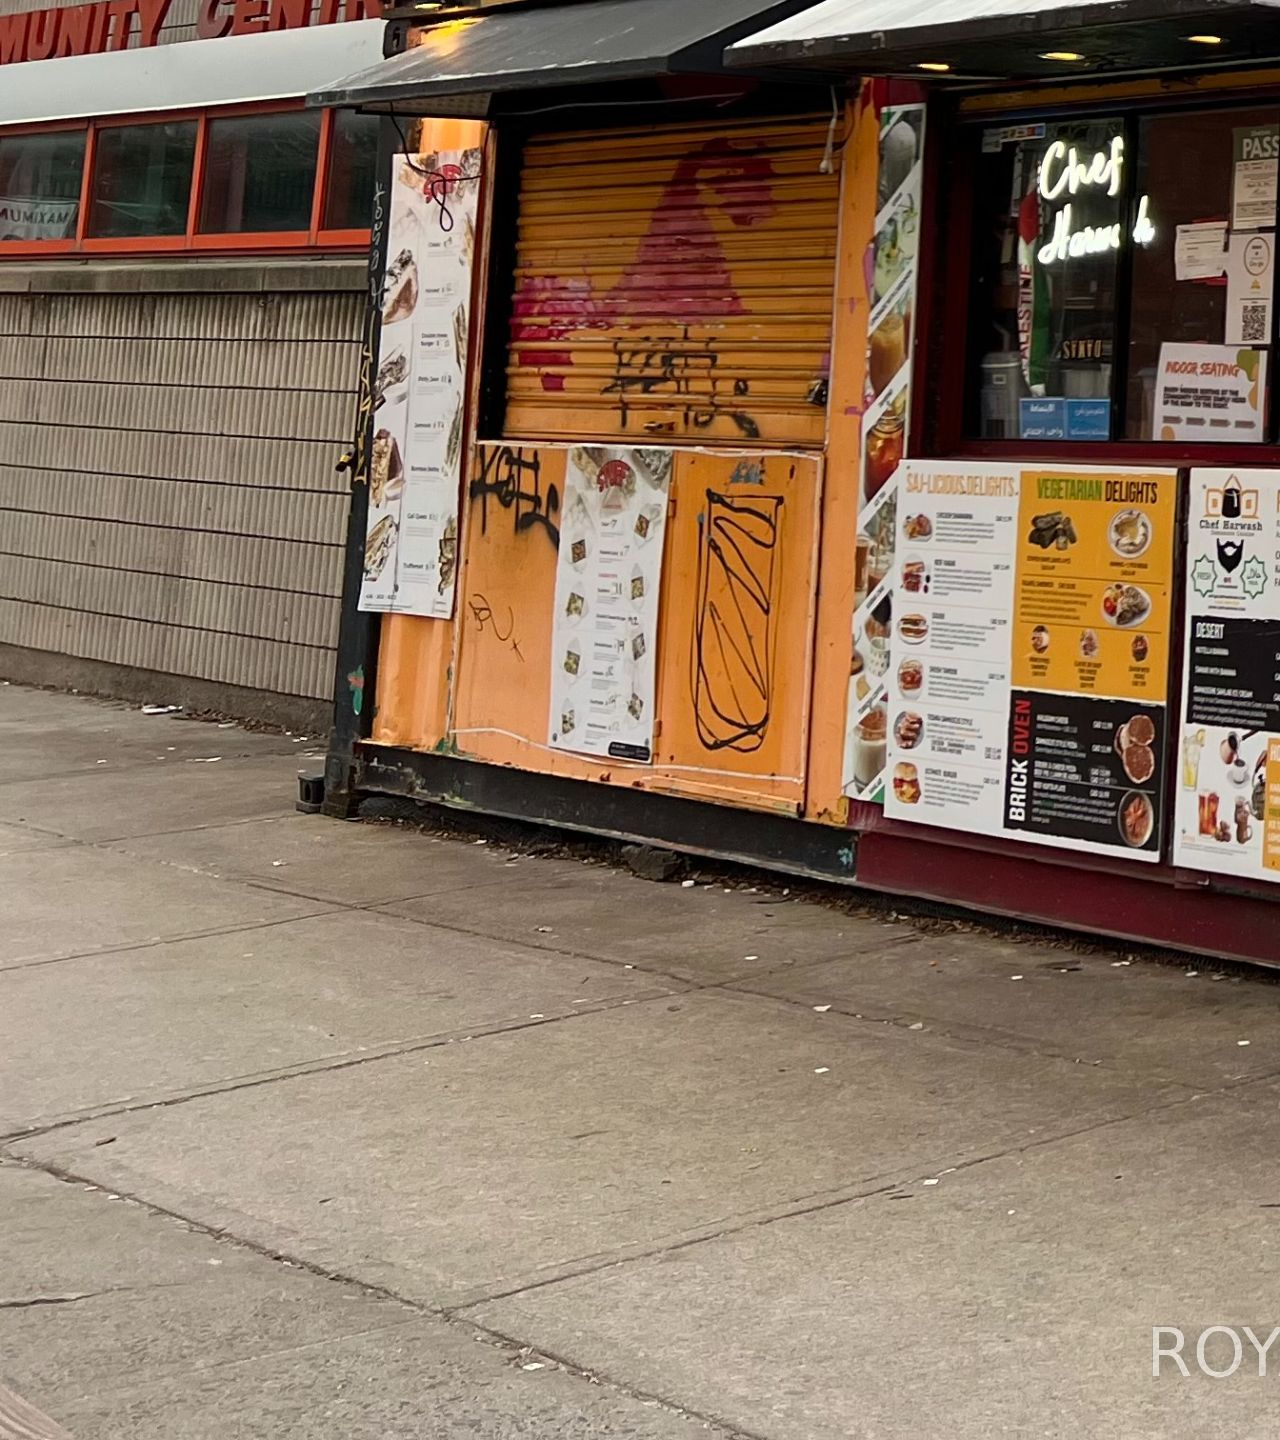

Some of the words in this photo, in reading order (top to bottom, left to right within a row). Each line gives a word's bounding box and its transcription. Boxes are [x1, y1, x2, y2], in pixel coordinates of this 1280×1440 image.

[1242, 136, 1279, 159] PASS
[1040, 136, 1124, 201] Chef
[1165, 361, 1197, 375] INDOOR
[1201, 362, 1240, 377] SEATING
[1037, 478, 1102, 501] VEGETARIAN
[1105, 481, 1158, 504] DELIGHTS
[1200, 520, 1219, 529] Chef
[1223, 520, 1262, 531] Harwash
[1013, 700, 1032, 755] OVEN
[1009, 759, 1028, 821] BRICK
